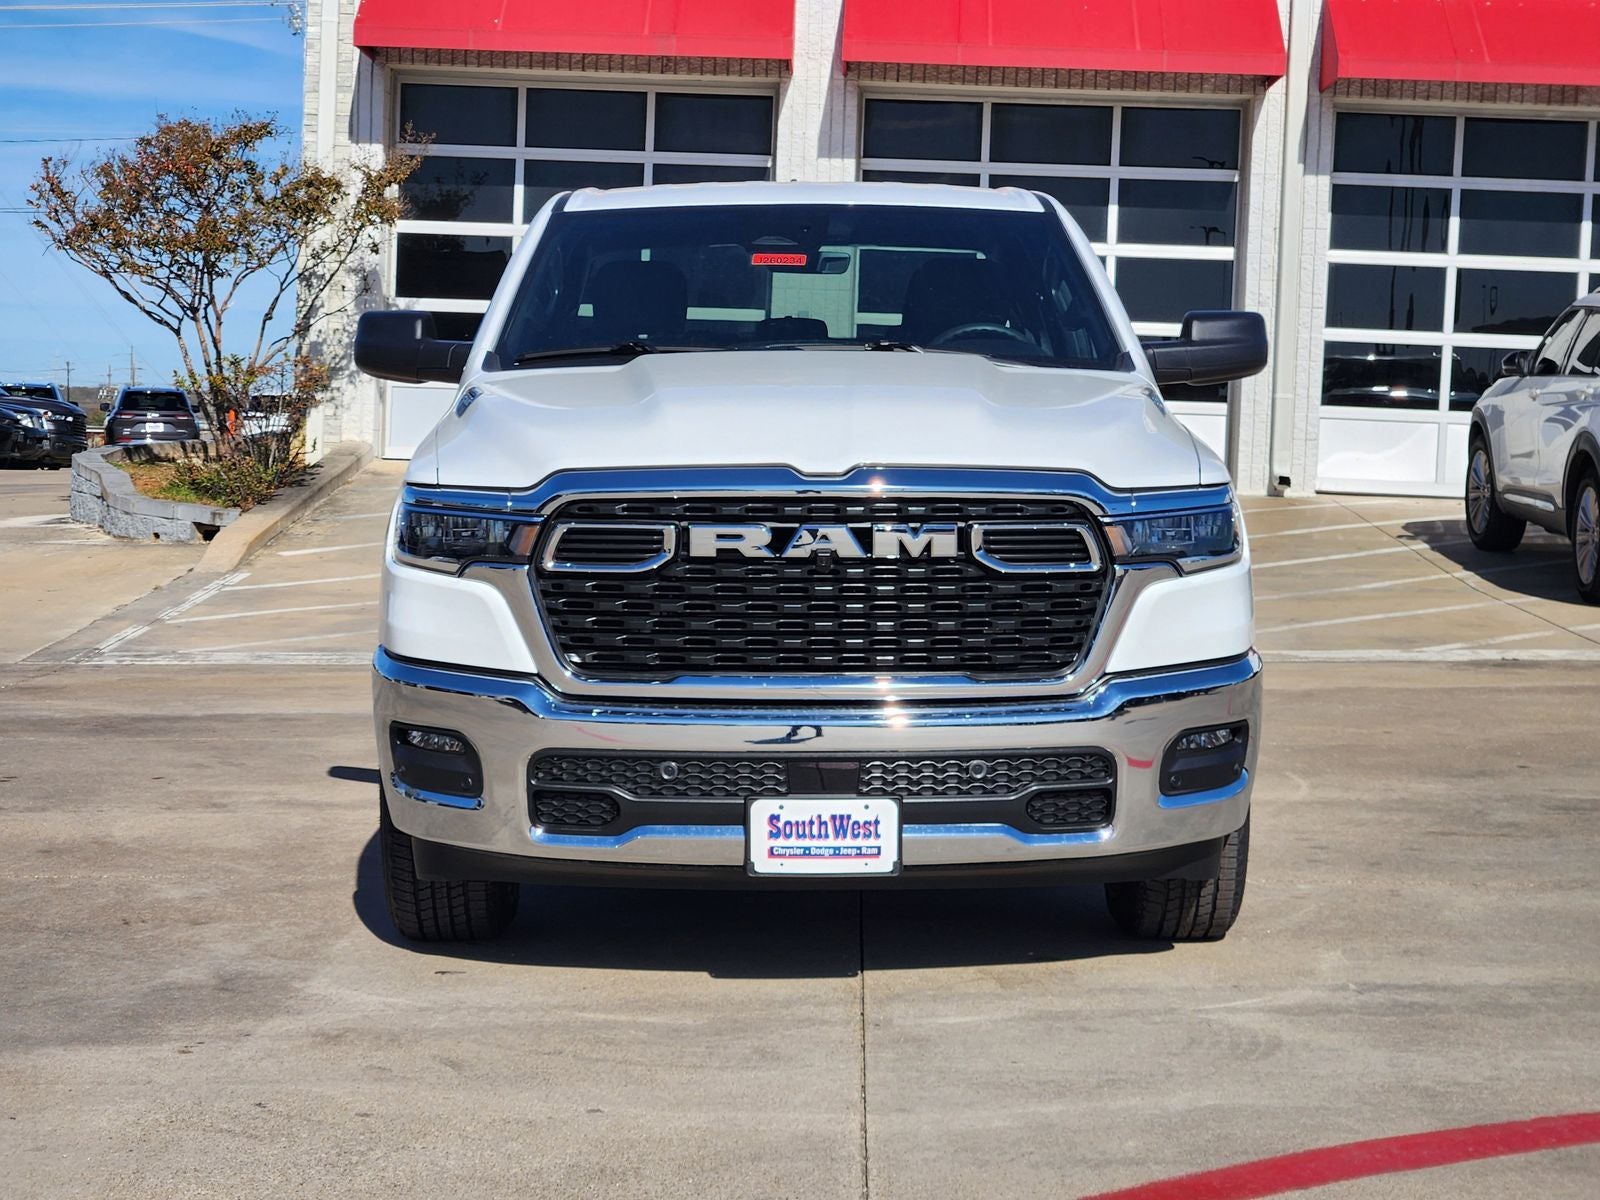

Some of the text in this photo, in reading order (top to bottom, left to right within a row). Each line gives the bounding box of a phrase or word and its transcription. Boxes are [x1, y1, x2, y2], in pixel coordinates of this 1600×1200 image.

[755, 256, 802, 264] J260234
[689, 523, 959, 558] RAM
[768, 813, 881, 841] SouthWest
[773, 847, 878, 857] Chrysler Dodge Jeep Ram
